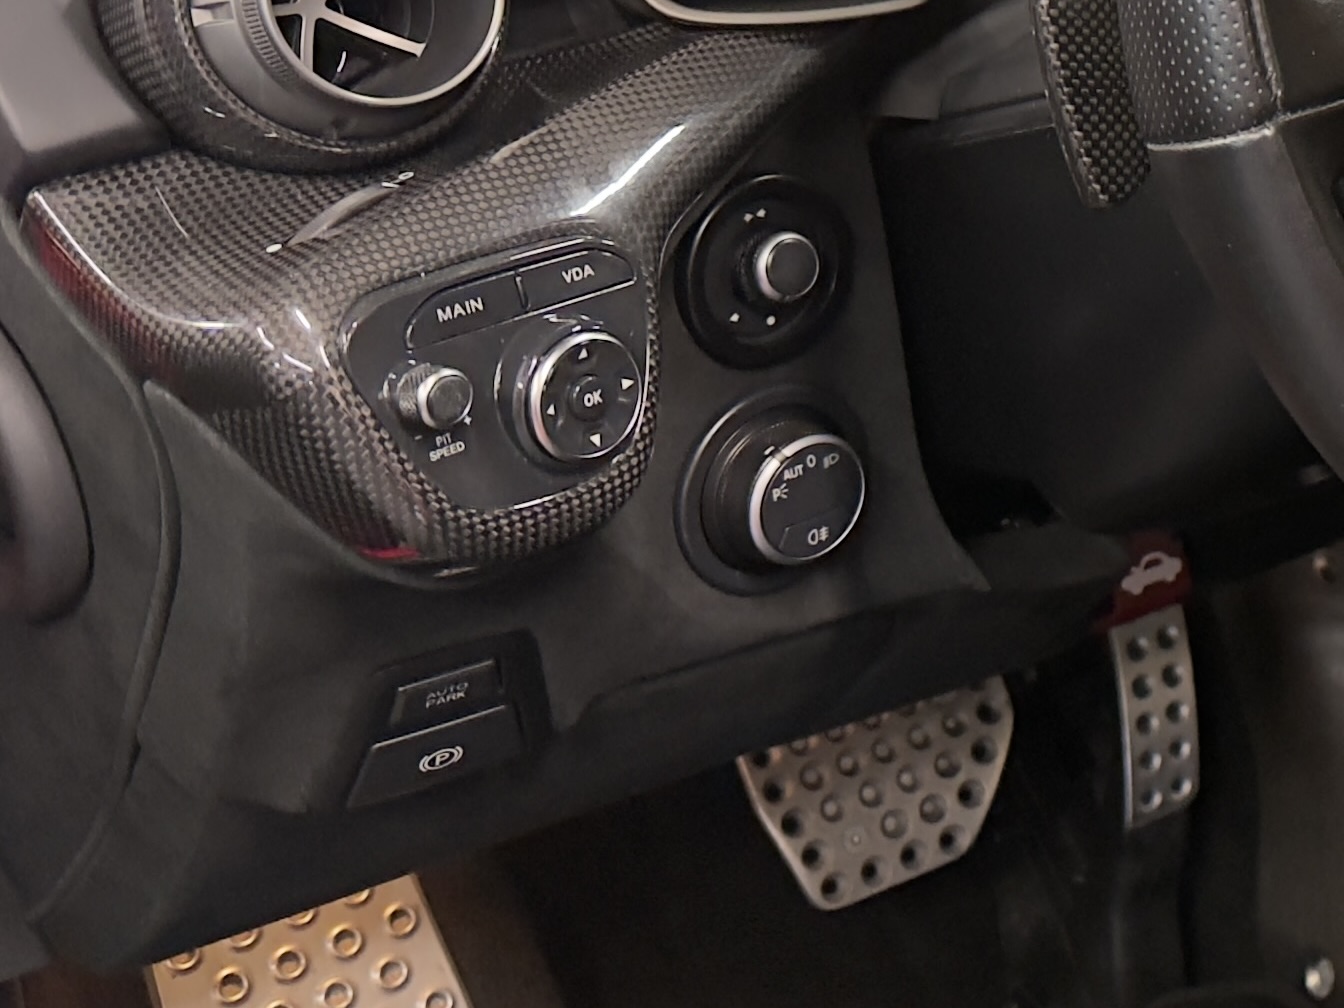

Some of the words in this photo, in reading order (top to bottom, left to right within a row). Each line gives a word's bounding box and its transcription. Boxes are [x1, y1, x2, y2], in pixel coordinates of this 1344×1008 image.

[561, 264, 595, 284] VDA
[436, 296, 484, 323] MAIN
[583, 388, 603, 407] OK
[435, 432, 452, 447] PIT
[429, 440, 466, 462] SPEED
[426, 682, 469, 700] AUTO
[426, 691, 465, 708] PARK
